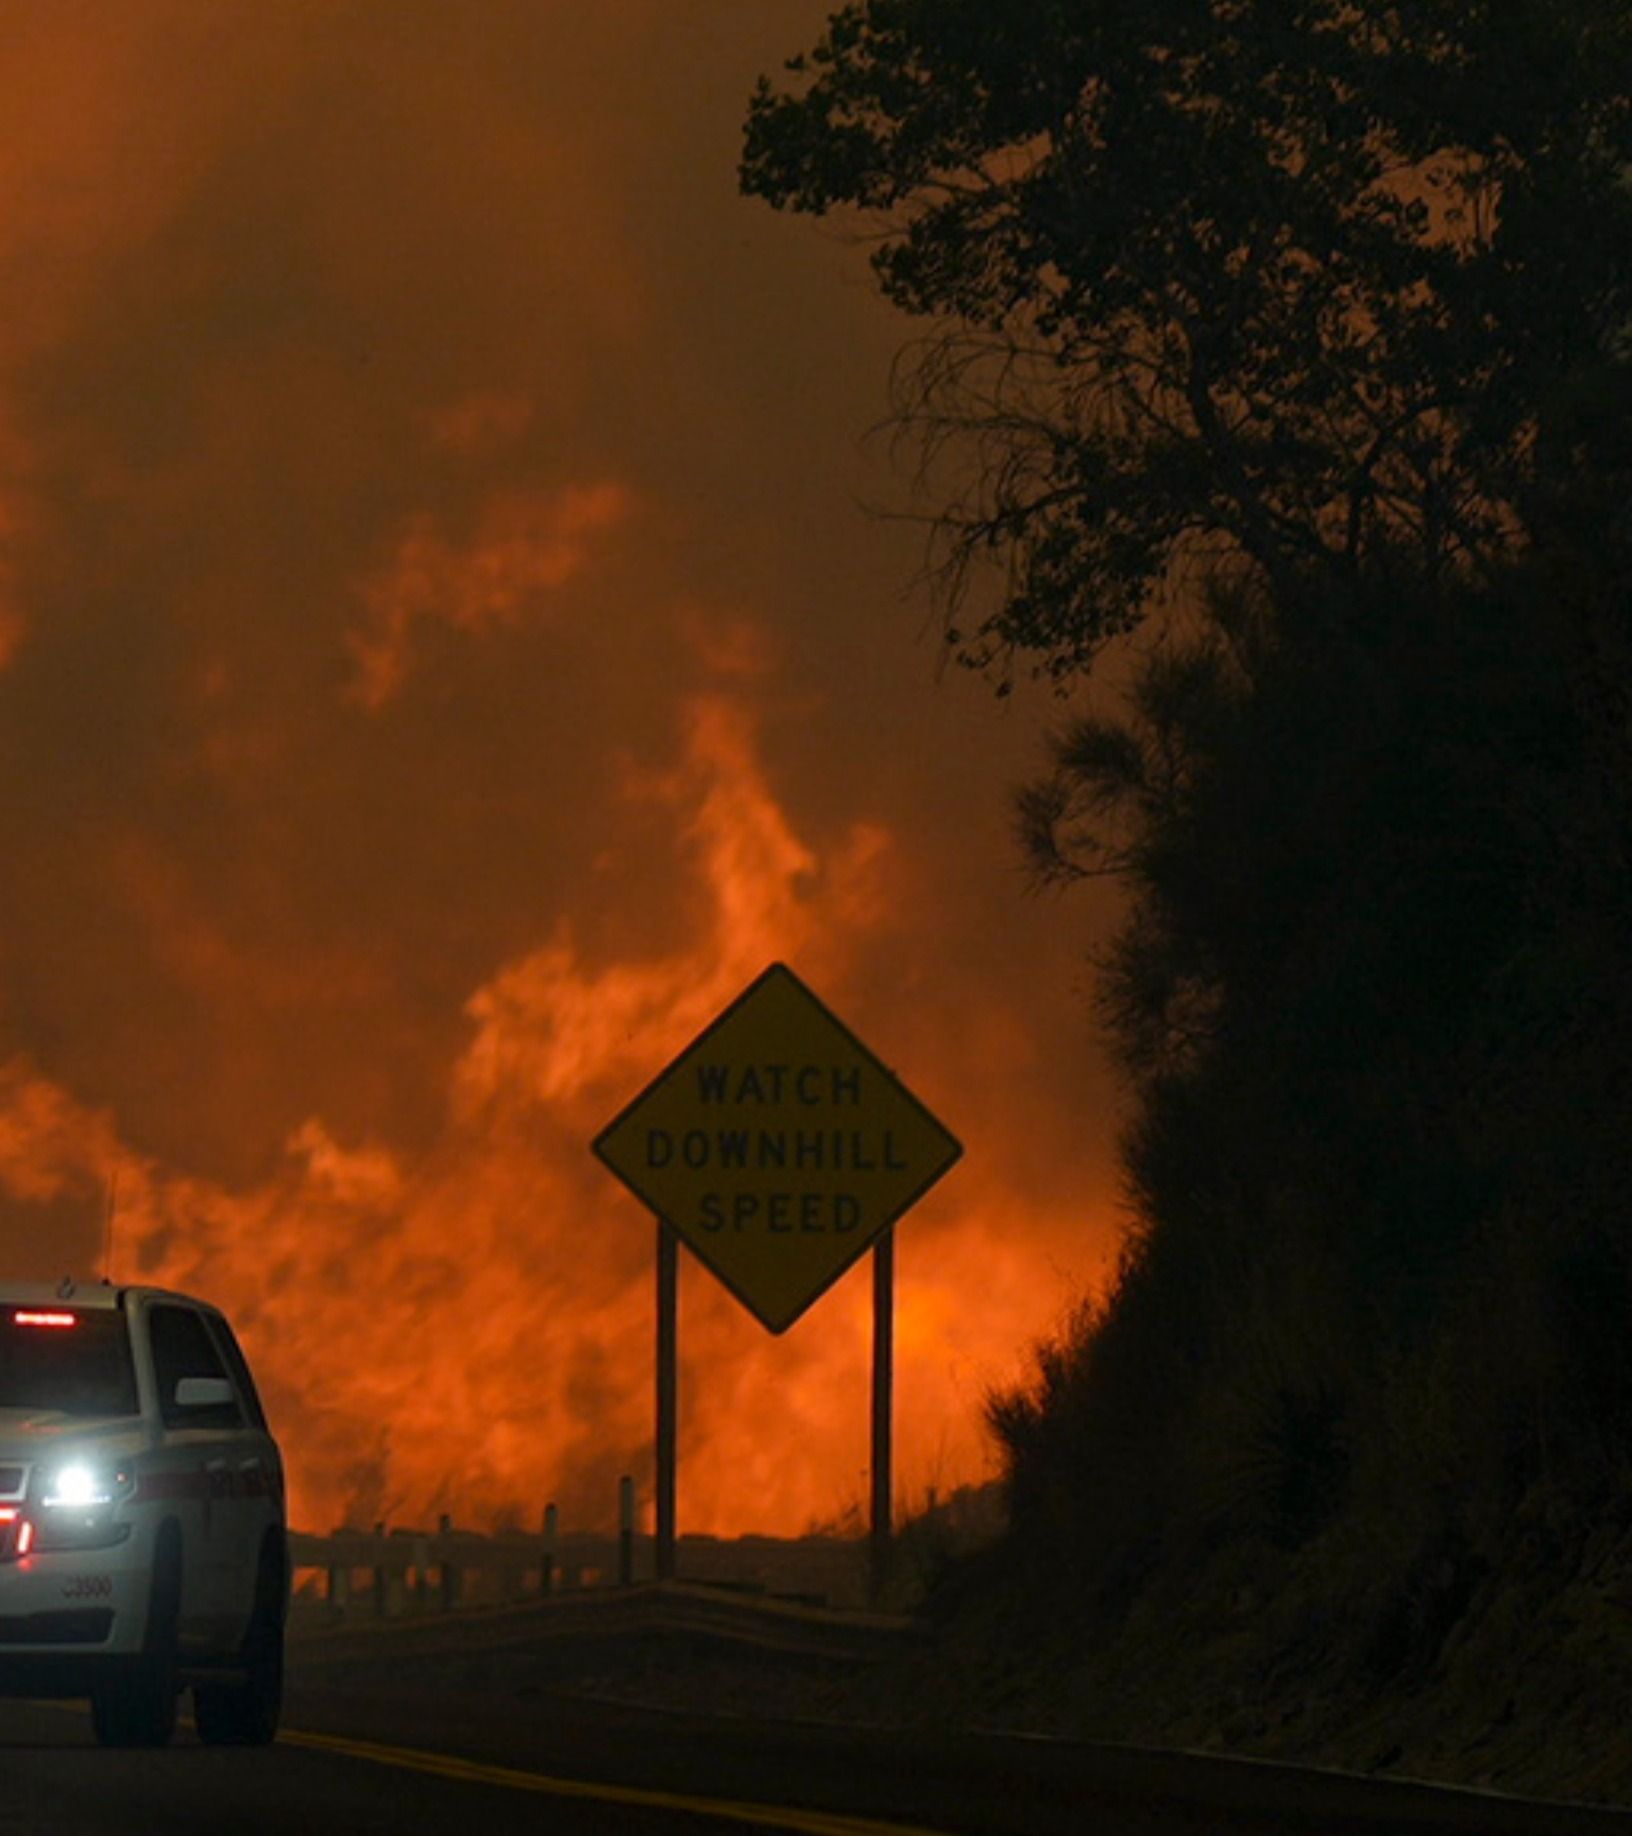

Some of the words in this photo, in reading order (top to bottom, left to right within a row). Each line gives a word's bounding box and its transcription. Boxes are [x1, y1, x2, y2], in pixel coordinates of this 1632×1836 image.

[697, 1066, 861, 1105] WATCH
[647, 1130, 908, 1169] DOWNHILL
[701, 1194, 861, 1233] SPEED
